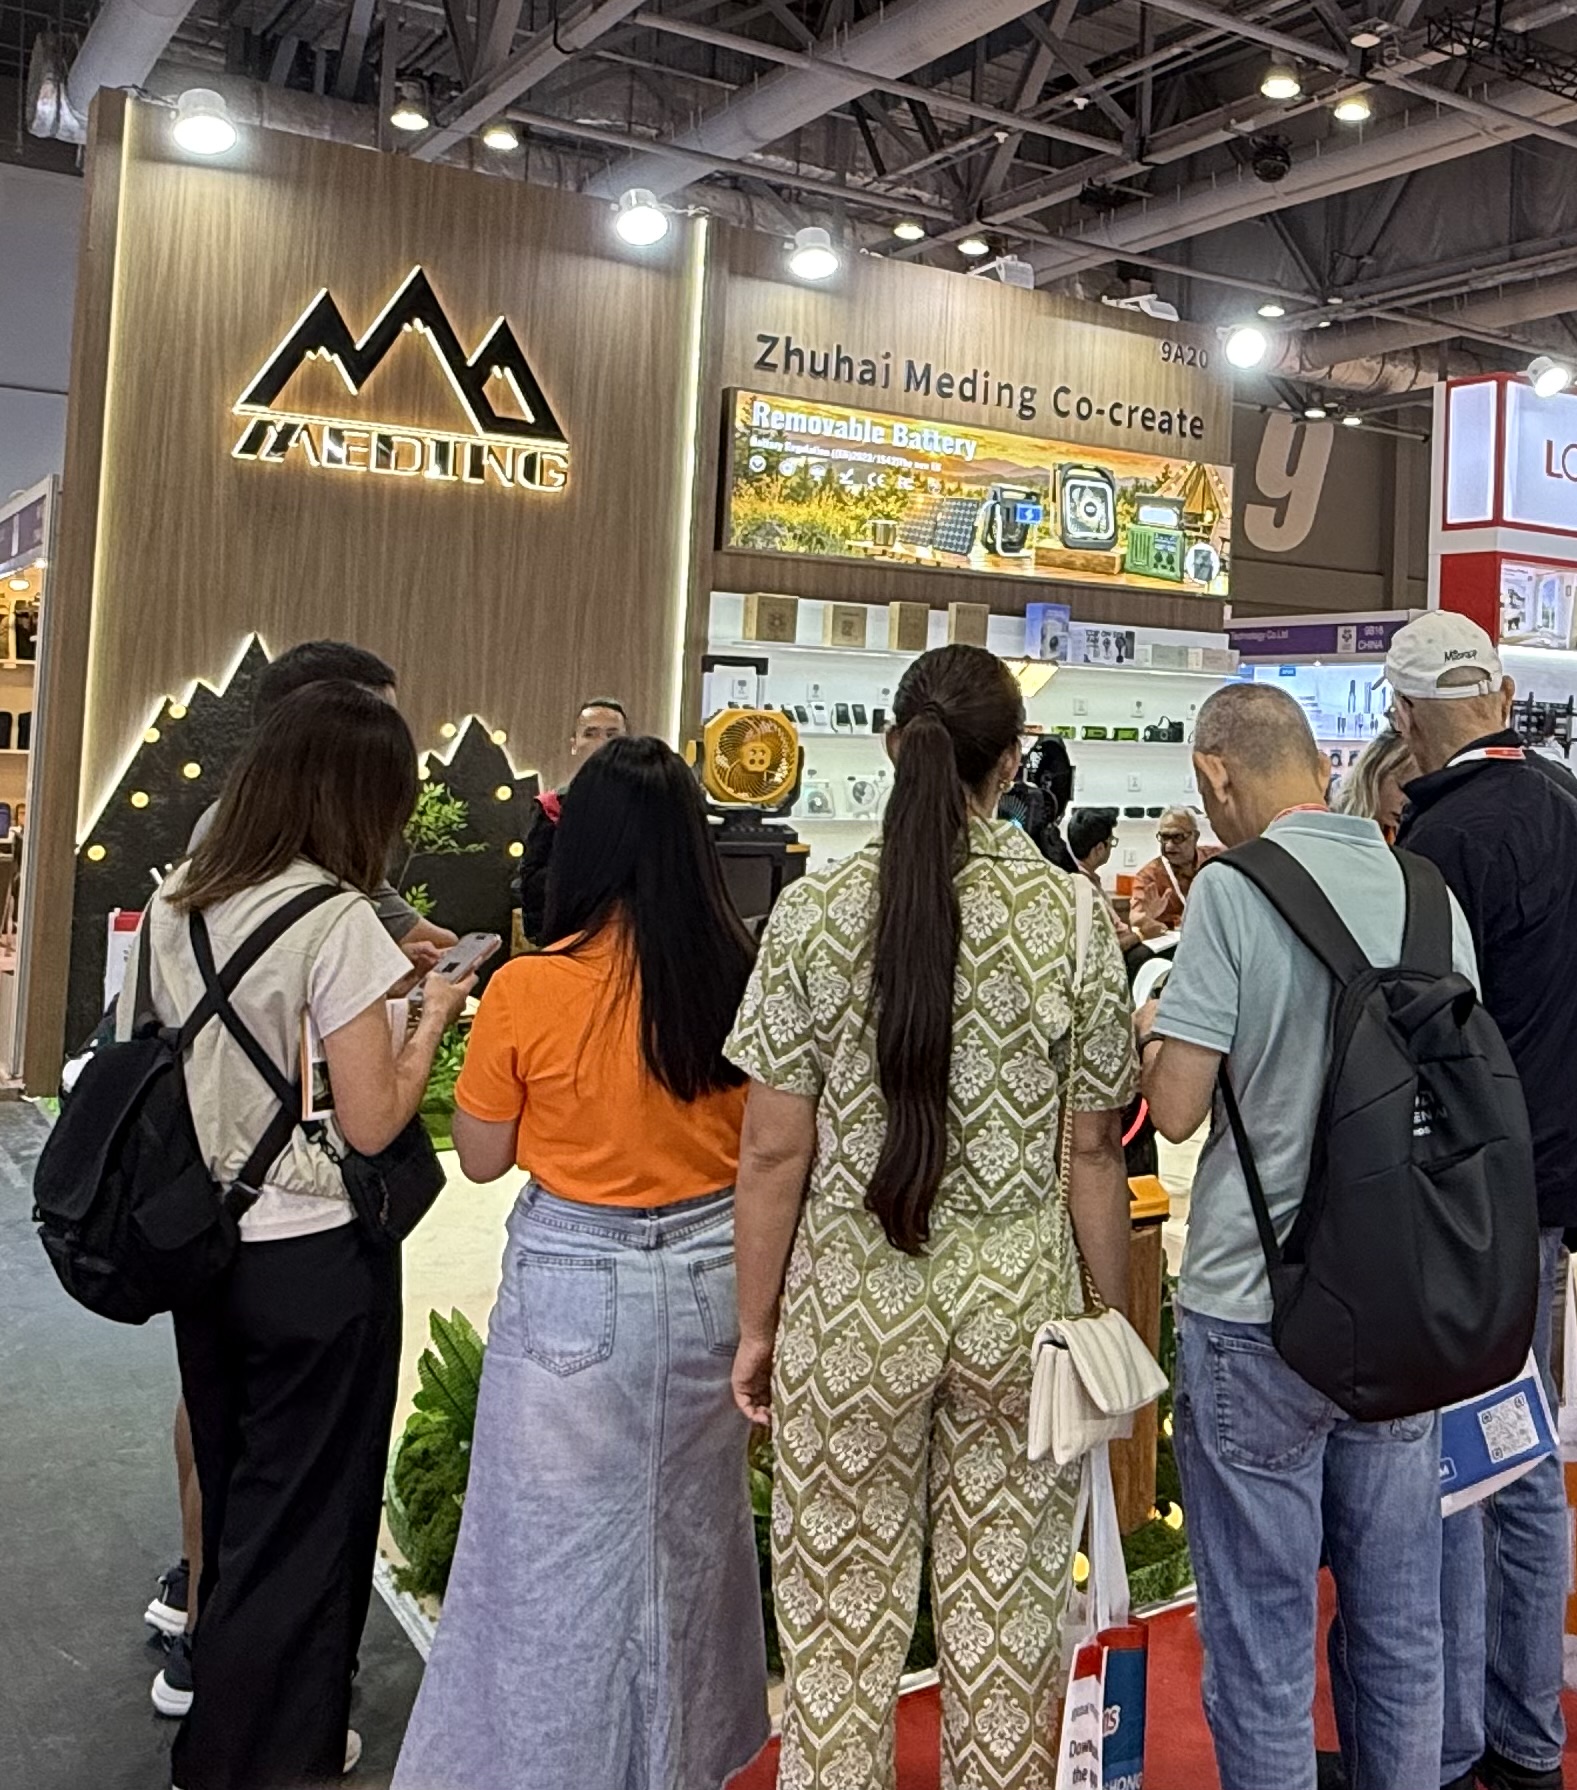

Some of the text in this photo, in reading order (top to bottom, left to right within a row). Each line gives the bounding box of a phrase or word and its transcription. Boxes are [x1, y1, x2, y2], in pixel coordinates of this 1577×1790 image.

[754, 333, 1205, 440] Zhuhai Meding Co-create
[1160, 341, 1209, 369] 9A20
[231, 415, 569, 493] MEDING
[751, 400, 978, 462] Removable Battery
